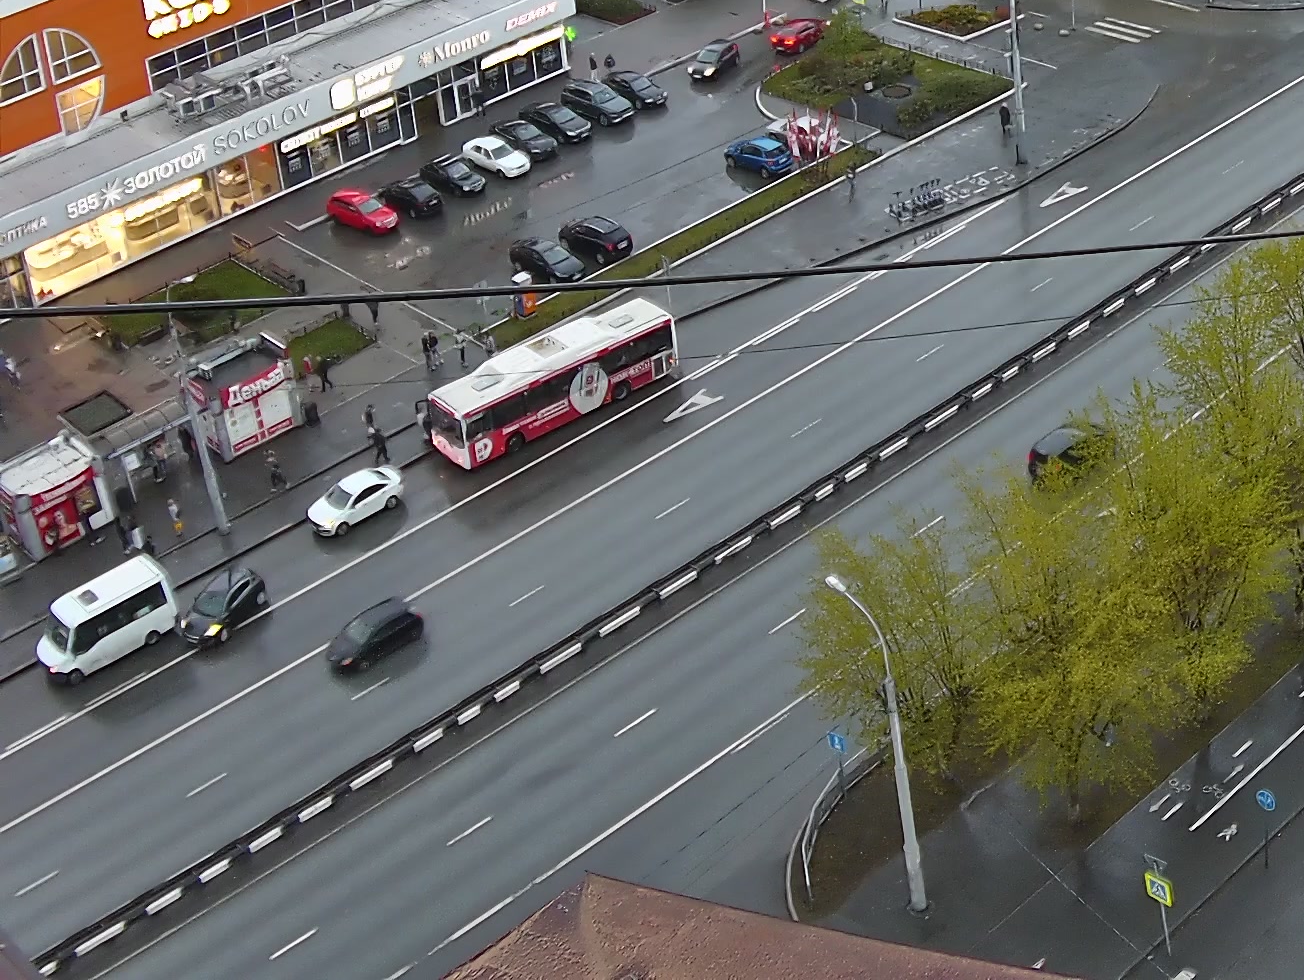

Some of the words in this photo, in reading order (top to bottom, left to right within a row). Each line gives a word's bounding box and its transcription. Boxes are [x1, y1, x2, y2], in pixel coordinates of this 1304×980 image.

[432, 29, 491, 63] Monro
[213, 97, 312, 156] SOKOLOV
[66, 192, 101, 220] 585
